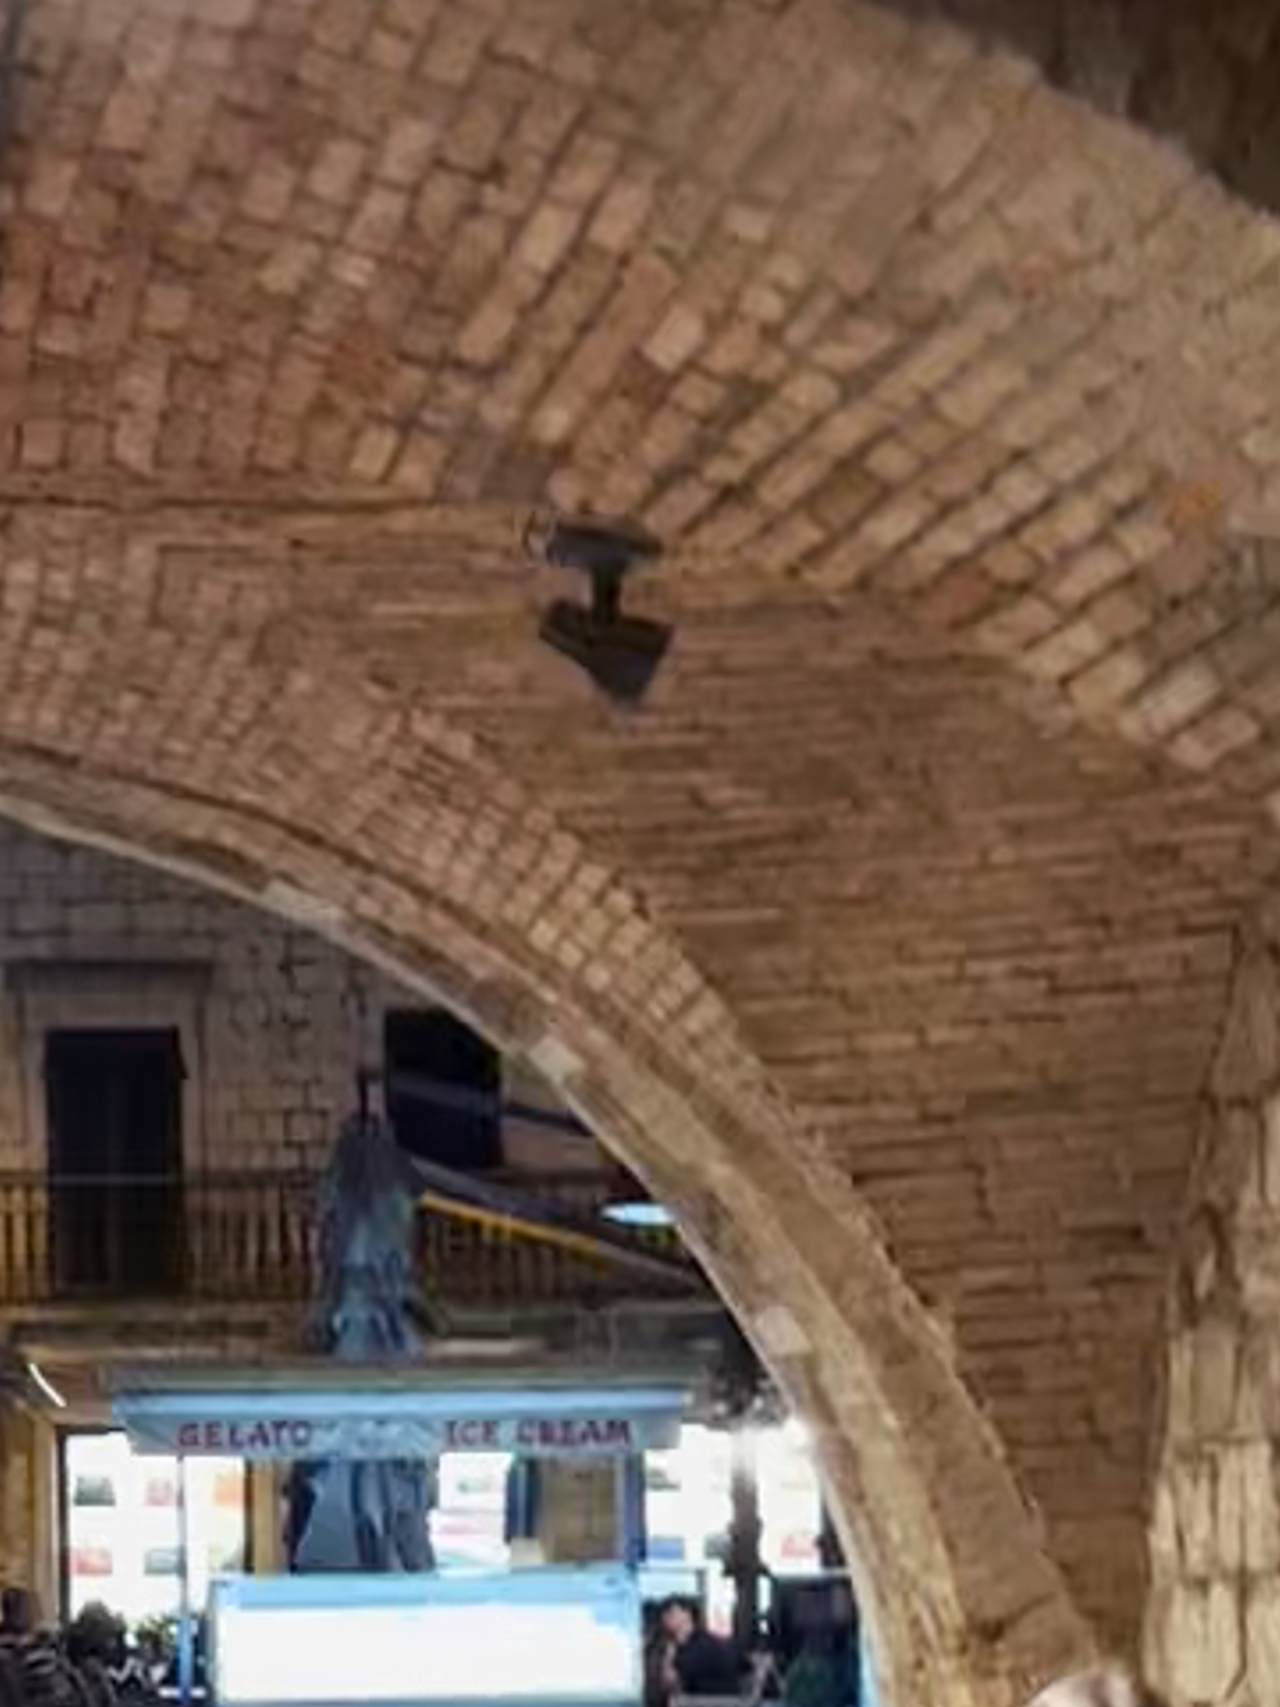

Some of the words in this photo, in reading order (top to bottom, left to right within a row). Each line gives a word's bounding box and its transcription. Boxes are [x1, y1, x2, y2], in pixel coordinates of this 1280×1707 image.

[177, 1420, 312, 1448] GELATO
[445, 1419, 498, 1445] ICE
[516, 1419, 633, 1446] CREAM
